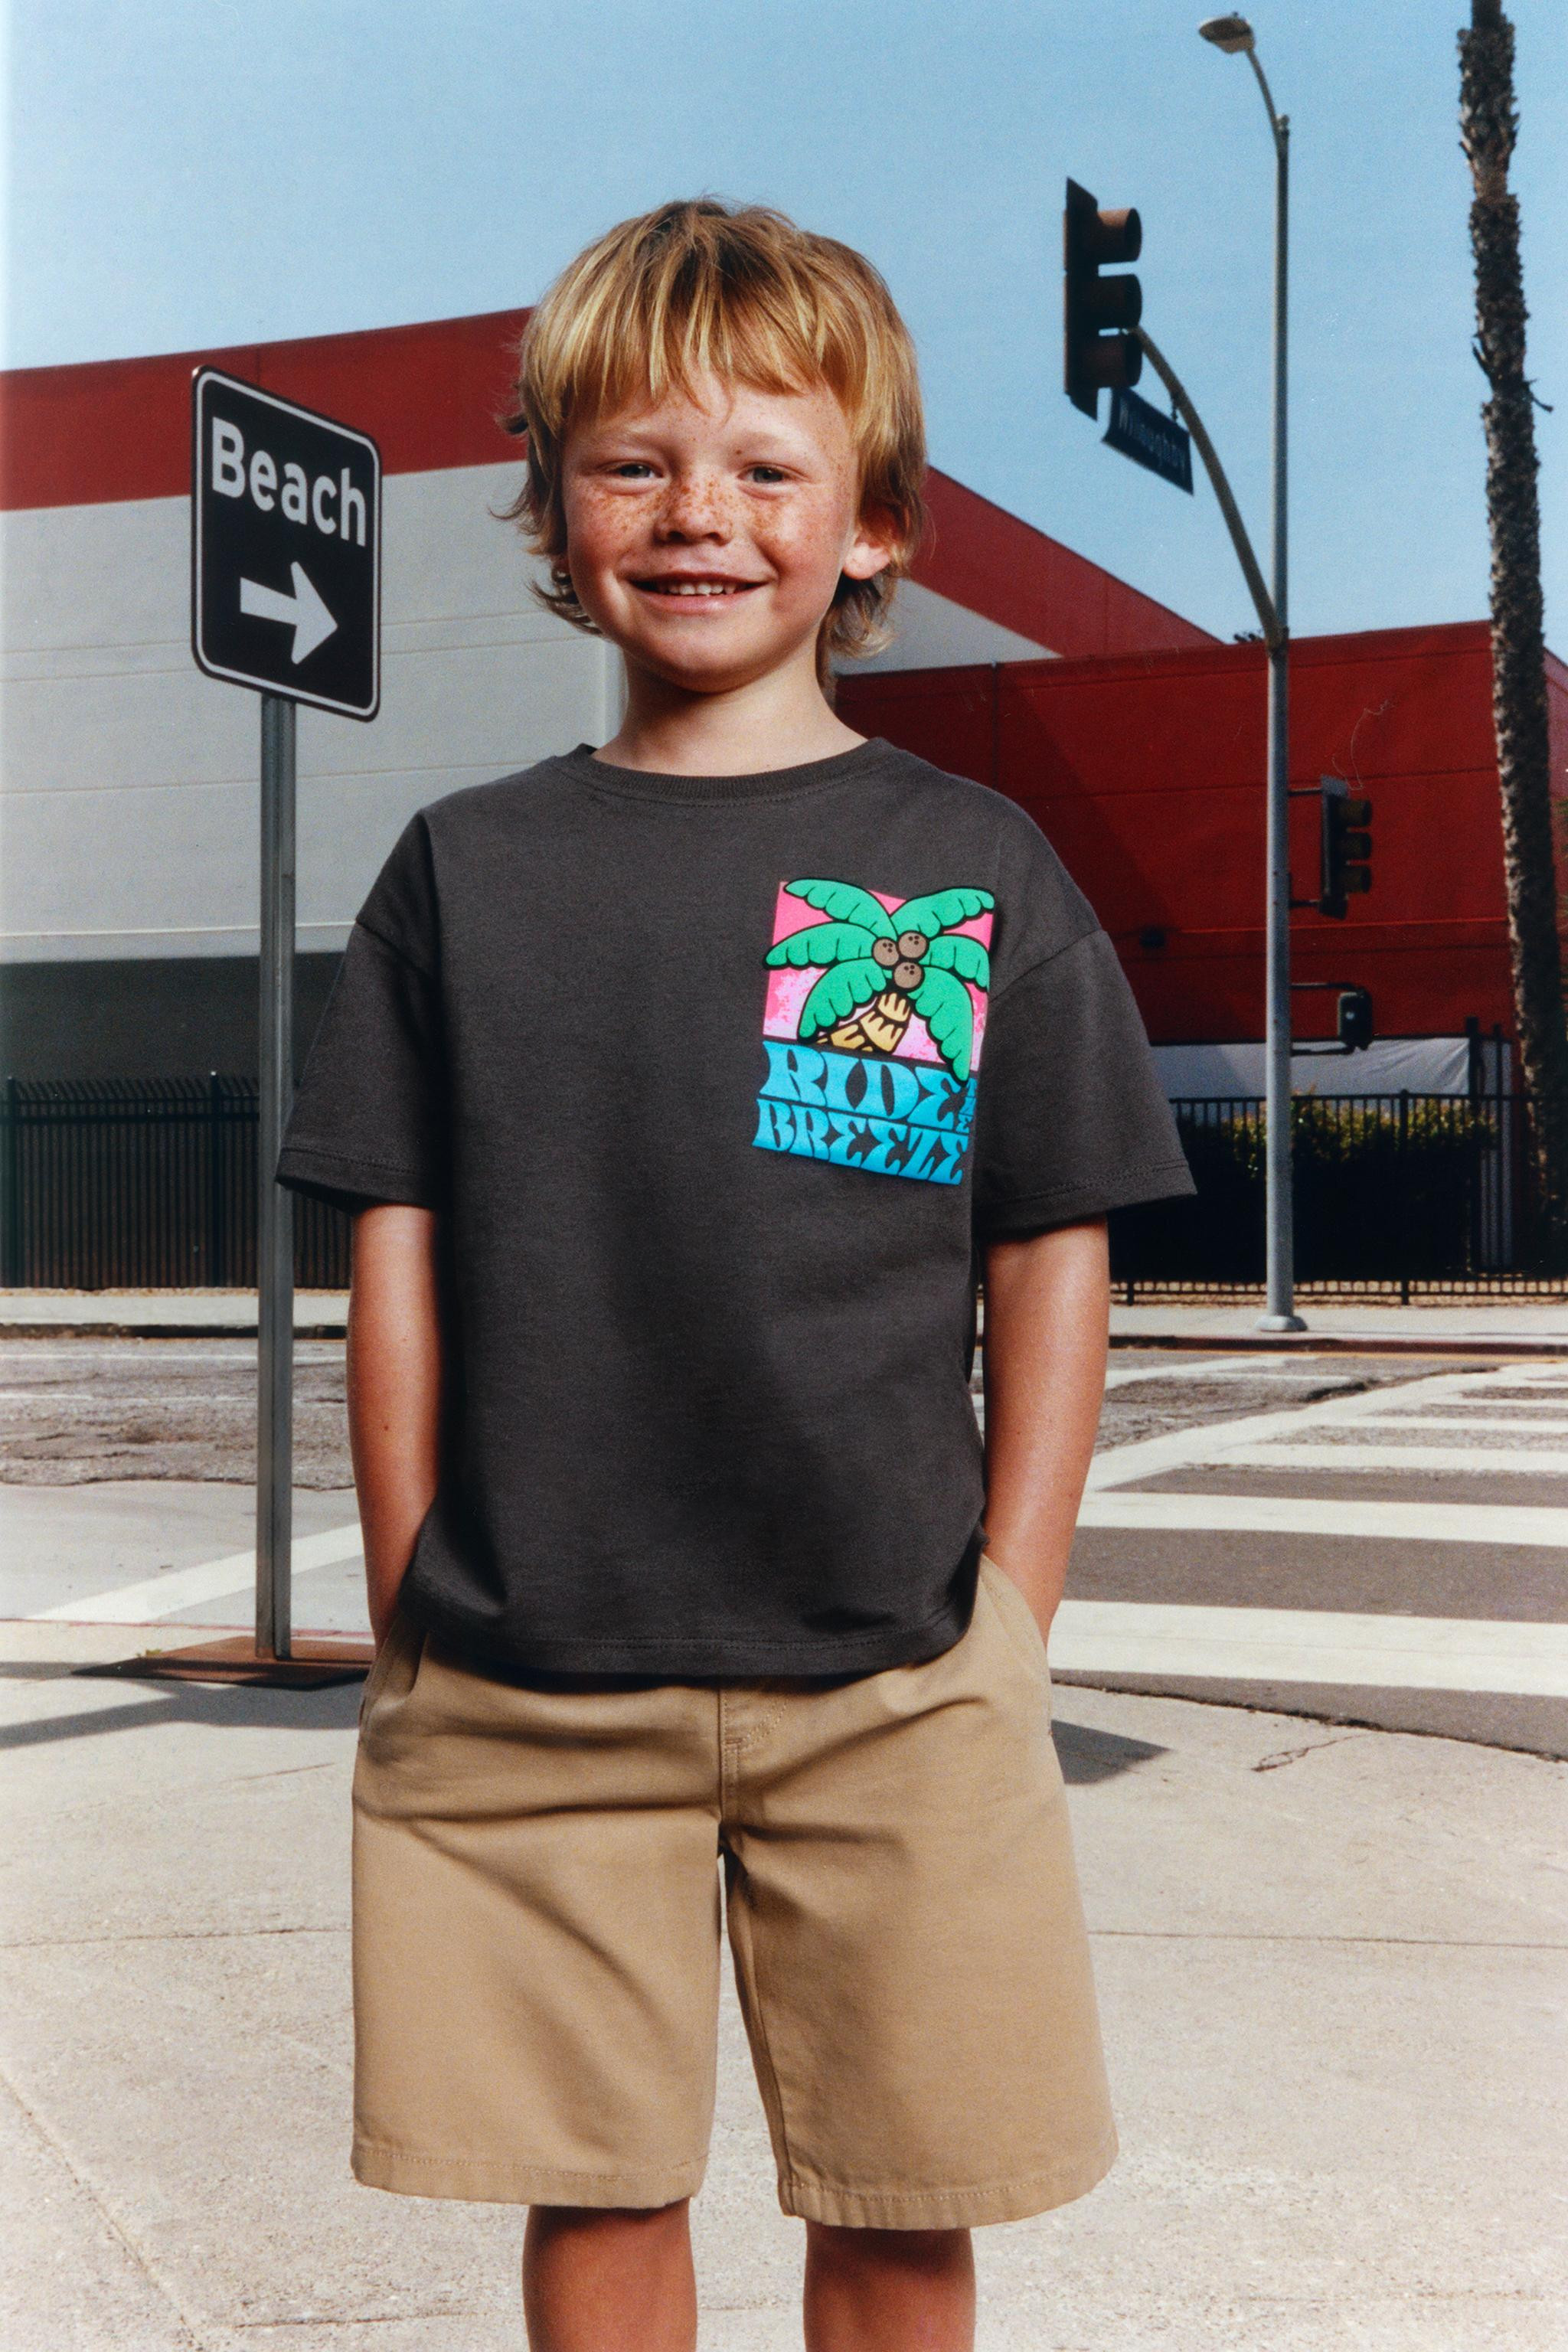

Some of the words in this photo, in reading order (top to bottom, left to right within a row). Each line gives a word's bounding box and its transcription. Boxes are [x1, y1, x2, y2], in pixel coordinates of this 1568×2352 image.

[211, 416, 366, 548] Beach
[759, 1040, 962, 1131] RIDE
[751, 1098, 970, 1186] BREEZE
